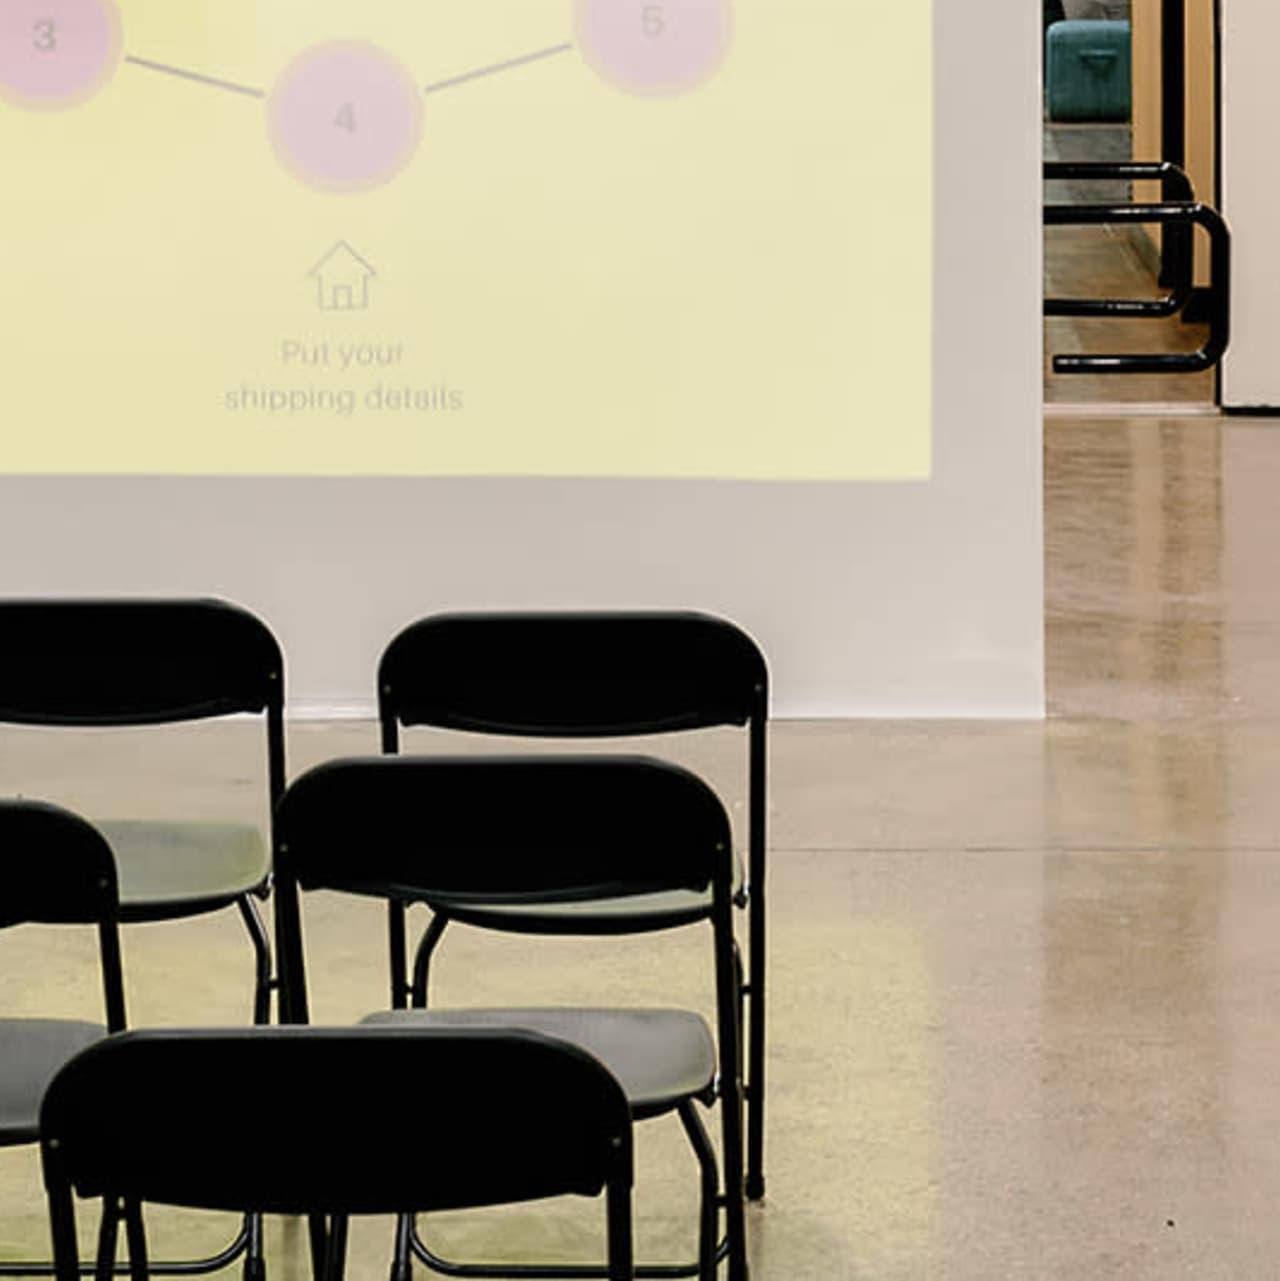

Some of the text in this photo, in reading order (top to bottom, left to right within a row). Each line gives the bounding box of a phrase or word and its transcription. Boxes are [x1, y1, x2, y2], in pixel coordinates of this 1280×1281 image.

[31, 19, 58, 52] 3
[640, 5, 665, 37] 5
[332, 101, 358, 136] 4
[281, 338, 328, 366] Put
[224, 380, 465, 419] shipping details
